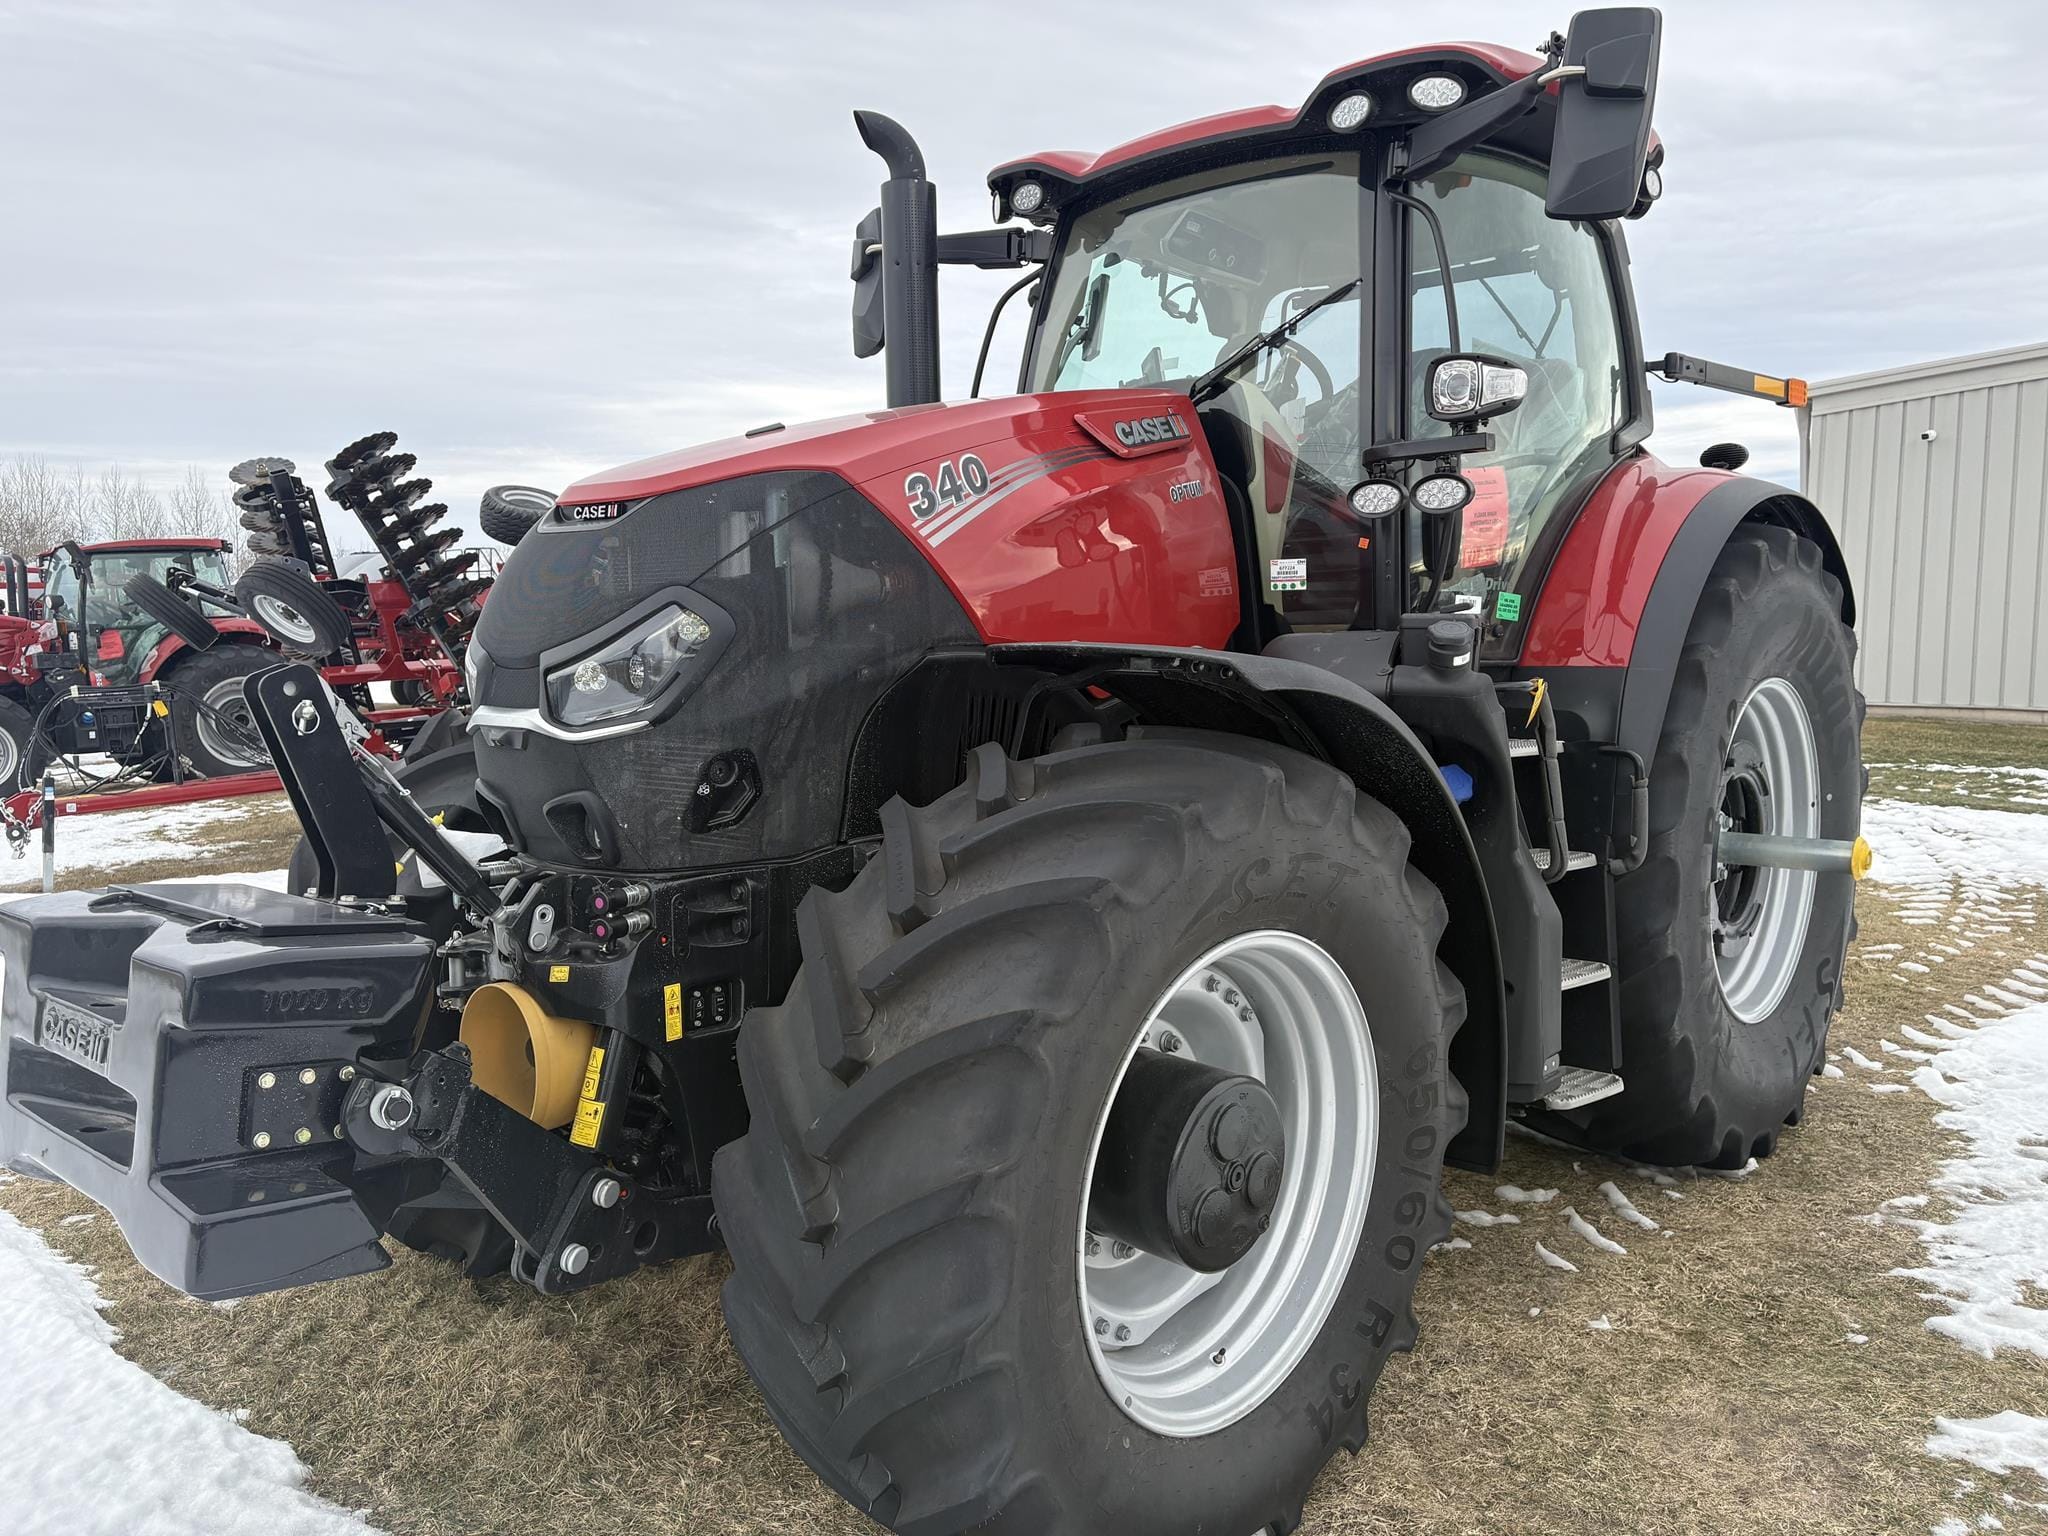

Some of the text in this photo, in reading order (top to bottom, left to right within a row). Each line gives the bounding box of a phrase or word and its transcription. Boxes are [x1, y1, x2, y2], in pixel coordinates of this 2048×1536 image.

[1114, 415, 1173, 446] CASE
[573, 505, 606, 520] CASE
[905, 453, 990, 521] 340
[1169, 480, 1203, 504] OPTUM
[43, 1006, 91, 1057] CASE
[1384, 1041, 1438, 1273] 650/60
[1354, 1298, 1396, 1350] R
